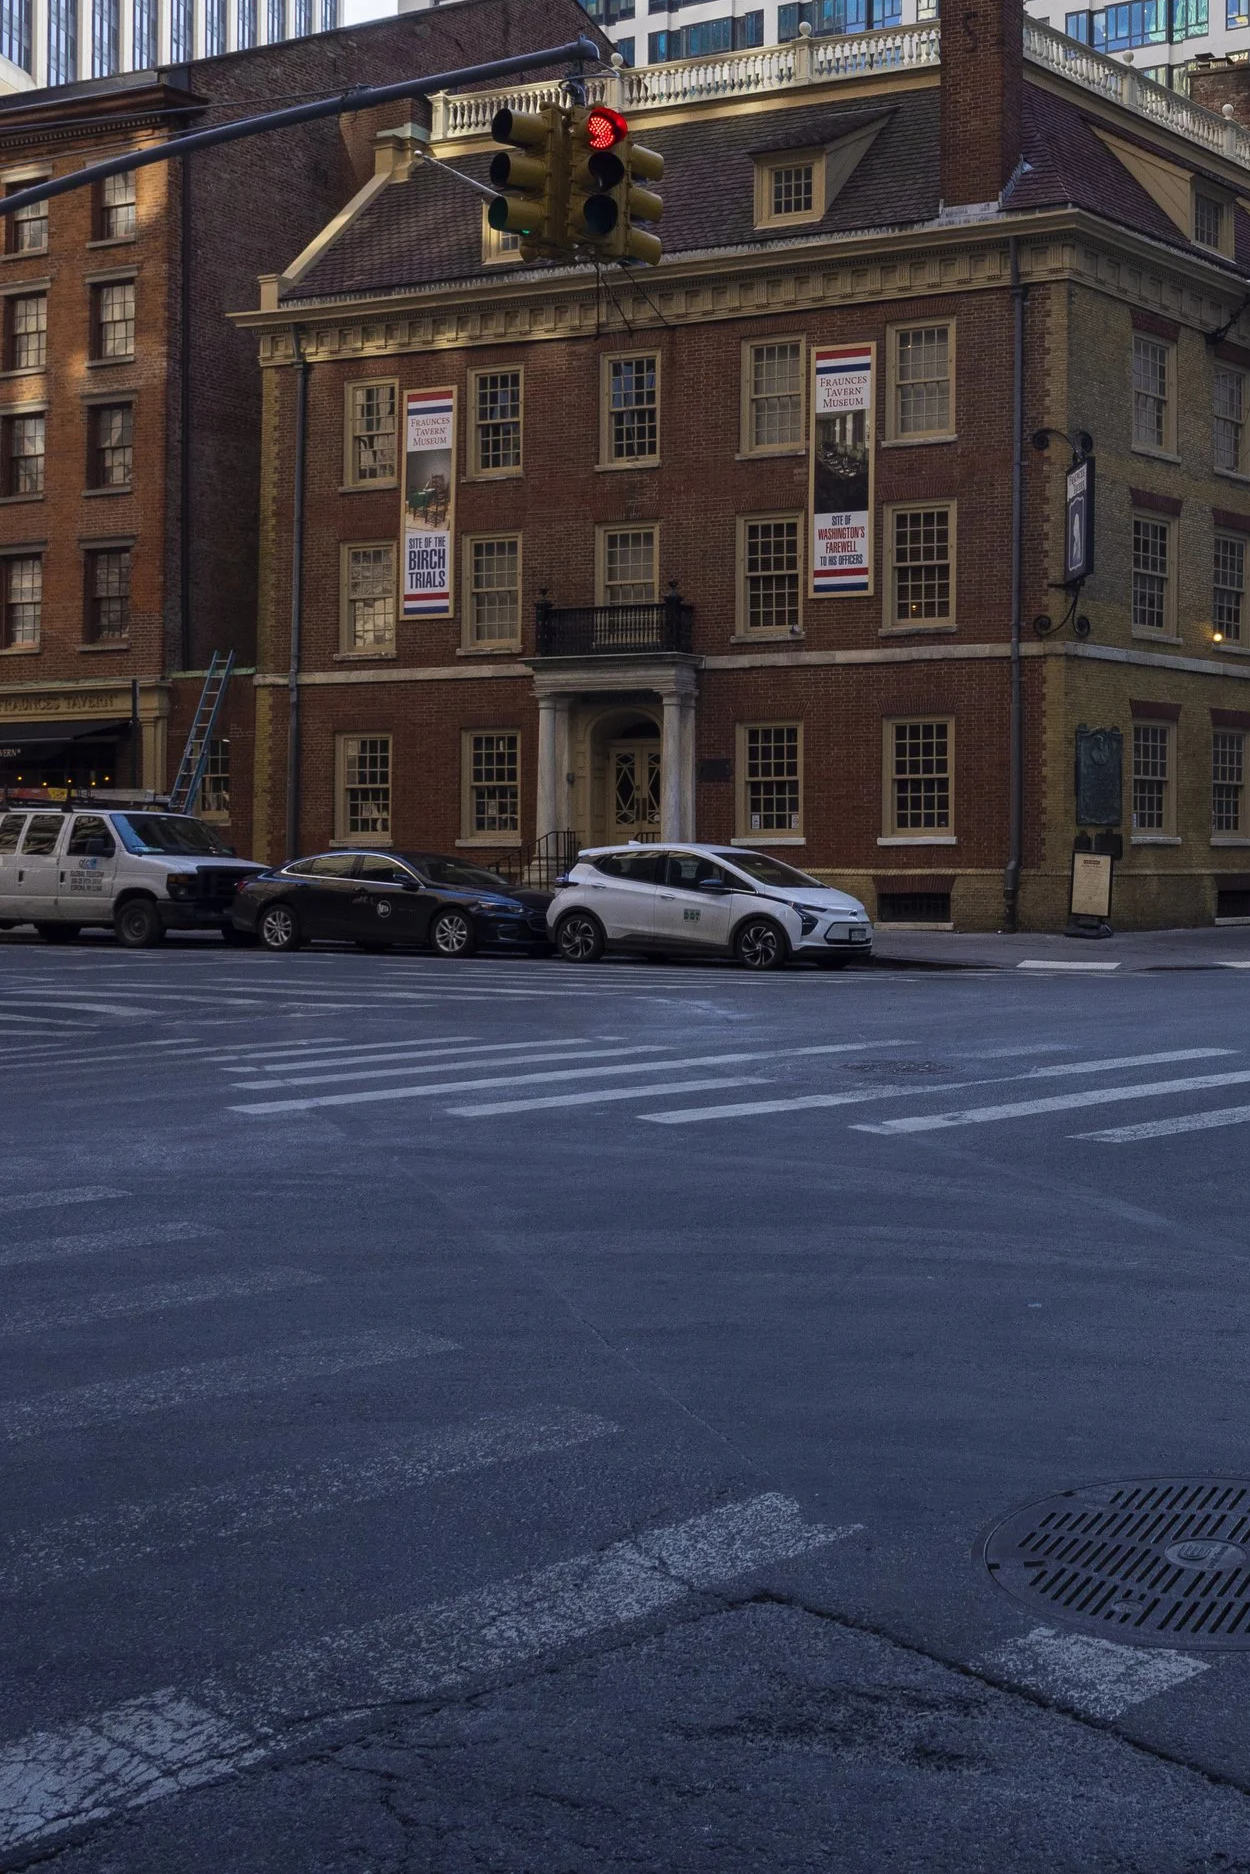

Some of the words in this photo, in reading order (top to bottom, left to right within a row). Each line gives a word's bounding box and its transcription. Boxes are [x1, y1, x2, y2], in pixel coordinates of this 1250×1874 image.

[820, 375, 867, 387] FRAUNCES
[825, 387, 862, 397] TAVERN
[823, 397, 864, 408] MUSEUM
[411, 417, 450, 427] FRAUNCES
[415, 427, 446, 437] TAVERN
[413, 436, 447, 447] MUSEUM
[832, 515, 843, 526] SITE
[845, 515, 852, 526] OF
[818, 526, 866, 541] WASHINGTON'S
[409, 537, 423, 549] SITE
[424, 537, 432, 548] OF
[434, 536, 446, 547] THE
[825, 540, 857, 554] FAREWELL
[409, 548, 446, 570] BIRCH
[820, 556, 828, 567] TO
[828, 555, 838, 566] HIS
[838, 554, 864, 566] OFFICERS
[408, 570, 446, 590] TRIALS
